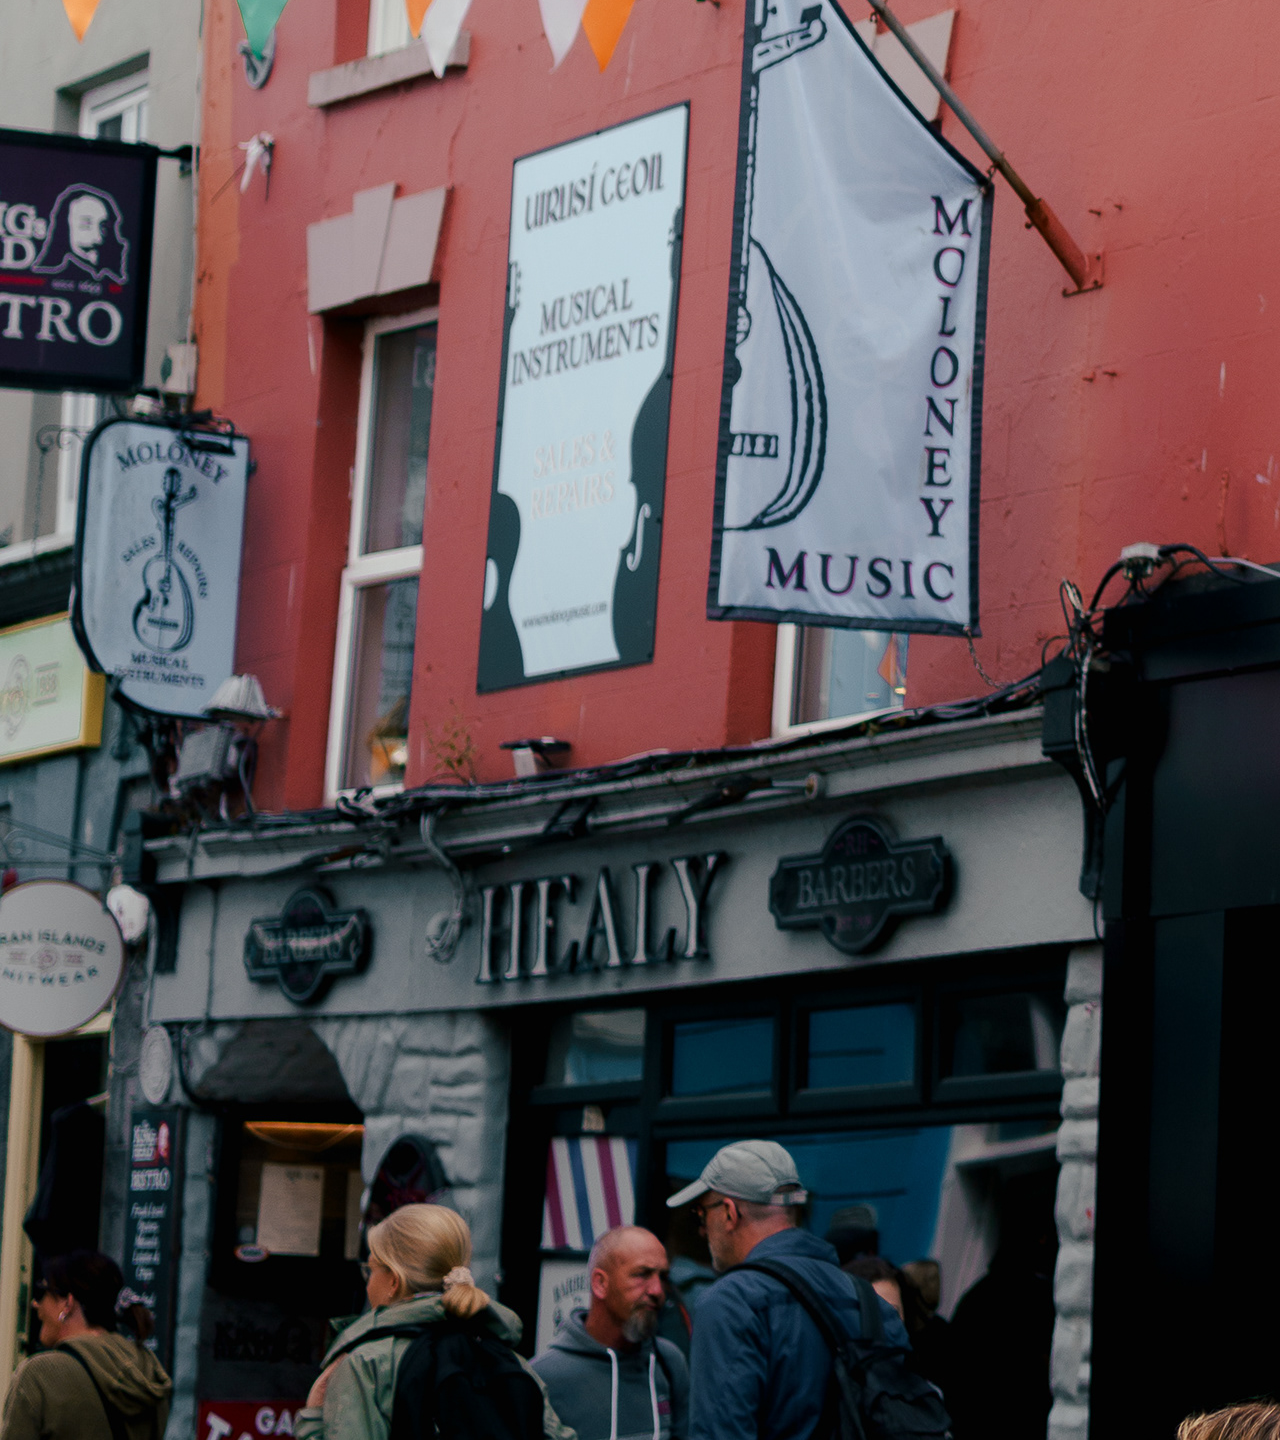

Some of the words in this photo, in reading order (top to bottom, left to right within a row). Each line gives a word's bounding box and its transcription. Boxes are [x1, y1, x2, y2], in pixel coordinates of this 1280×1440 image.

[540, 276, 633, 336] MUSICAL
[510, 313, 660, 386] INSTRUMENTS
[920, 195, 975, 540] MOLONEY
[116, 441, 229, 486] MOLONEY
[532, 432, 597, 480] SALES
[599, 429, 616, 462] &
[530, 470, 616, 521] REPAIRS
[764, 548, 957, 604] MUSIC
[797, 856, 917, 909] BARBERS
[38, 930, 106, 955] ISLANDS
[474, 850, 728, 986] HEALY
